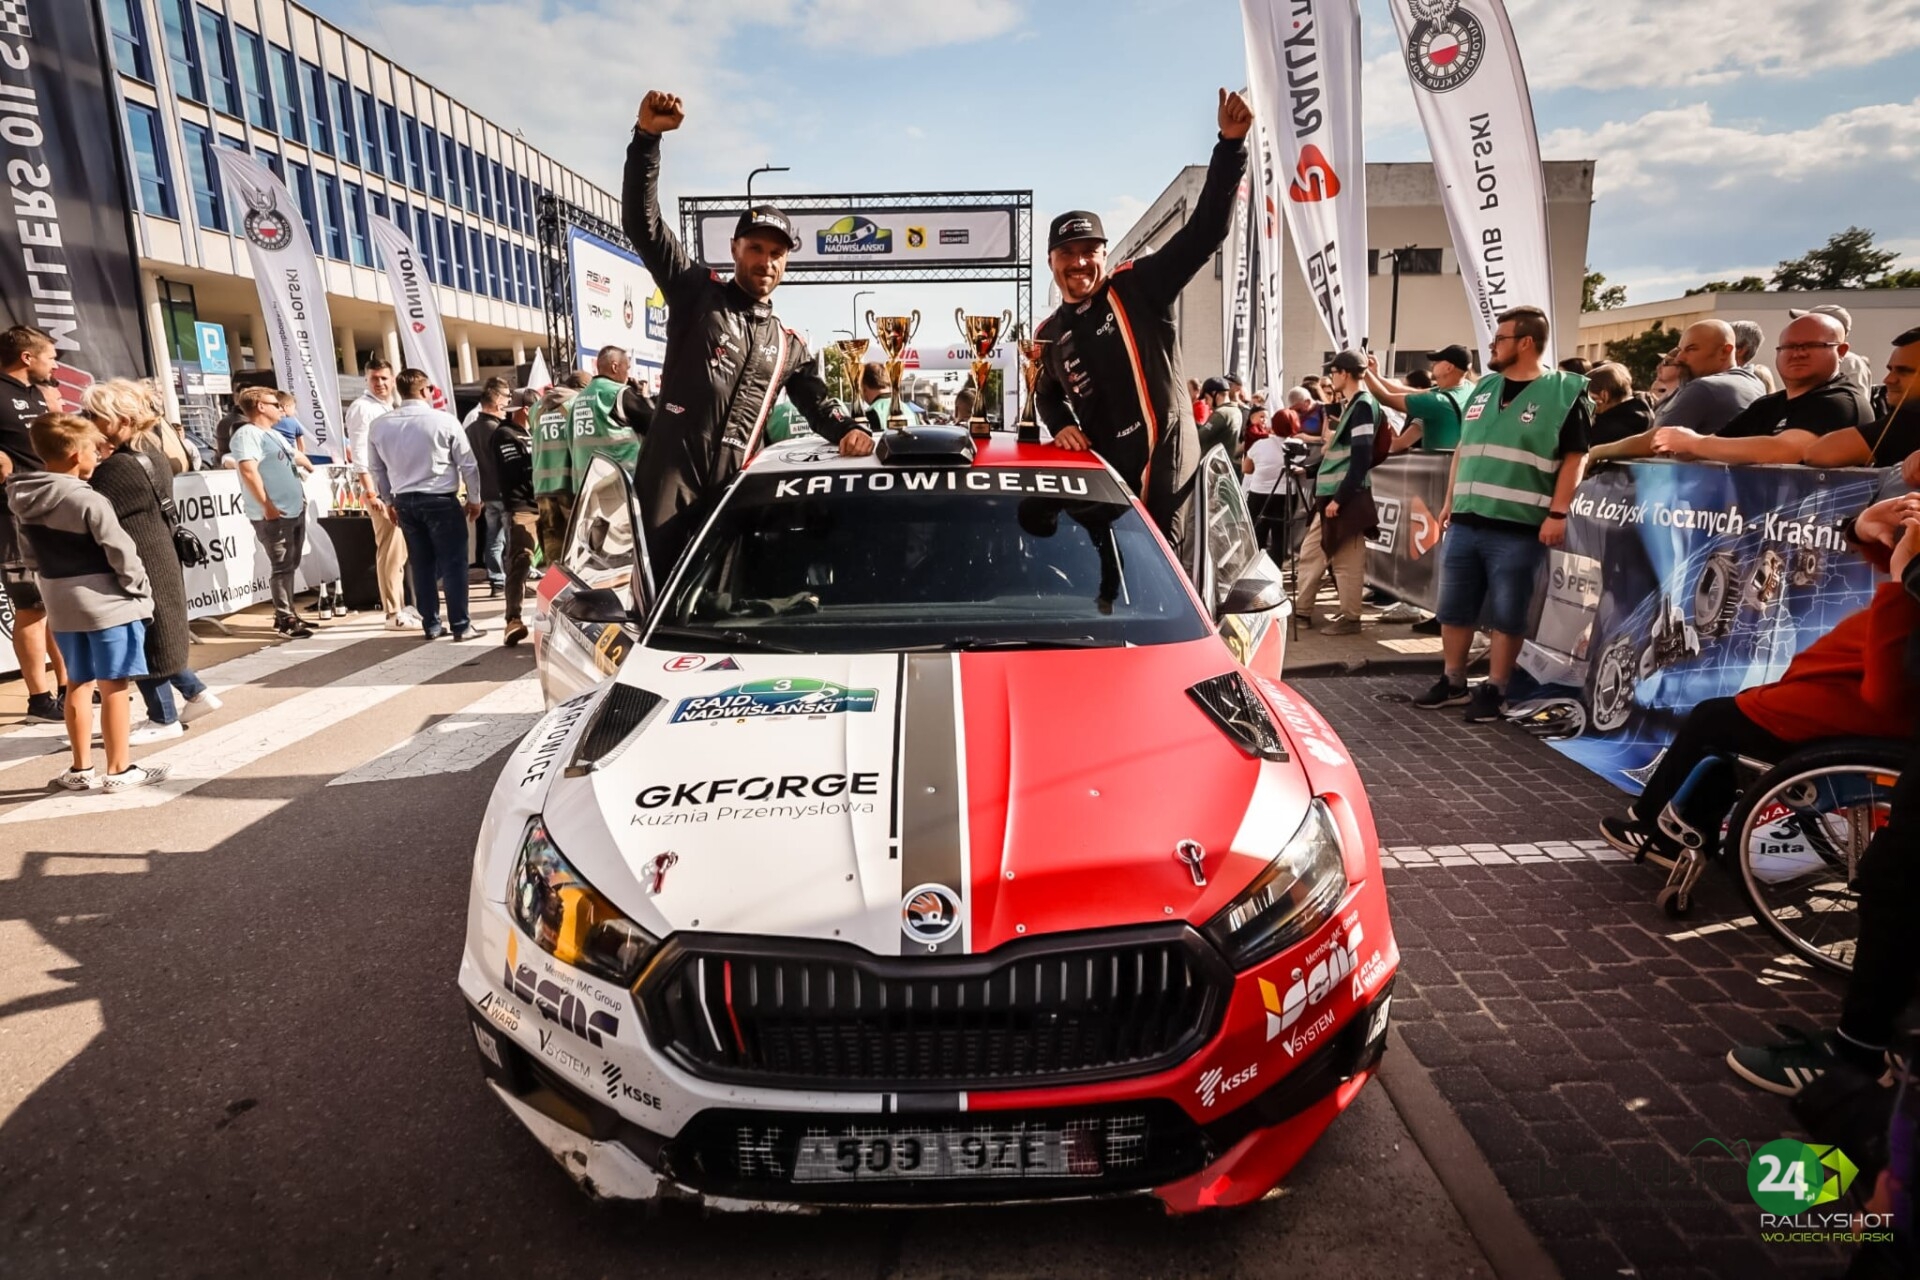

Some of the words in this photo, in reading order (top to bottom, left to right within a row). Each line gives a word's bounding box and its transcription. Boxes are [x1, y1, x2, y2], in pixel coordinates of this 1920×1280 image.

[824, 233, 851, 244] RAJD
[824, 242, 885, 254] NADWIŚLAŃSKI
[202, 327, 220, 360] P
[775, 471, 1089, 498] KATOWICE.EU
[1595, 496, 1649, 527] Łożysk
[1652, 502, 1743, 538] Tocznych
[773, 679, 792, 692] 3
[677, 701, 838, 722] NADWIŚLAŃSKI
[686, 694, 752, 710] RAJD
[519, 703, 589, 788] KATOWICE
[635, 772, 880, 810] GKFORGE
[630, 809, 708, 827] Kuźnia
[716, 800, 875, 822] Przemysłowa
[1760, 842, 1805, 855] lata
[544, 961, 575, 985] Member
[594, 990, 622, 1013] Group
[491, 1007, 519, 1032] WARD
[494, 997, 522, 1020] ATLAS
[1220, 1061, 1259, 1096] KSSE
[622, 1082, 662, 1111] KSSE
